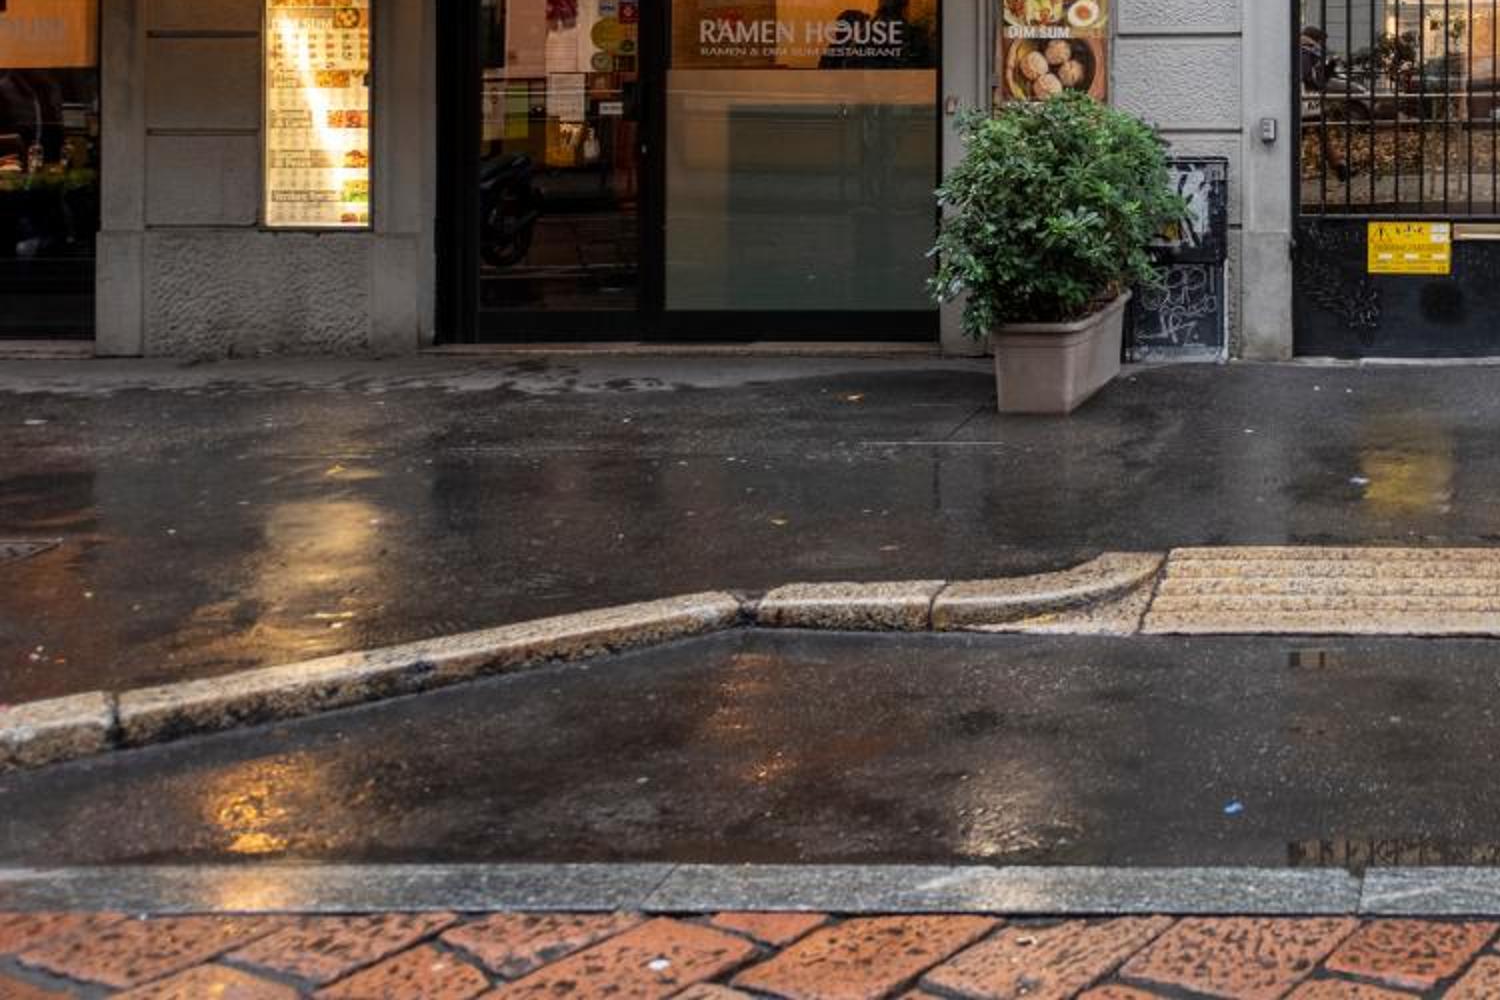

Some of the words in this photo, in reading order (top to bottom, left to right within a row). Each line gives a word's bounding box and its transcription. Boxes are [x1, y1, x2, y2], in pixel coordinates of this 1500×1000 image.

[699, 19, 795, 45] RAMEN
[805, 19, 904, 45] HOUSE
[821, 47, 903, 57] RESTAURANT
